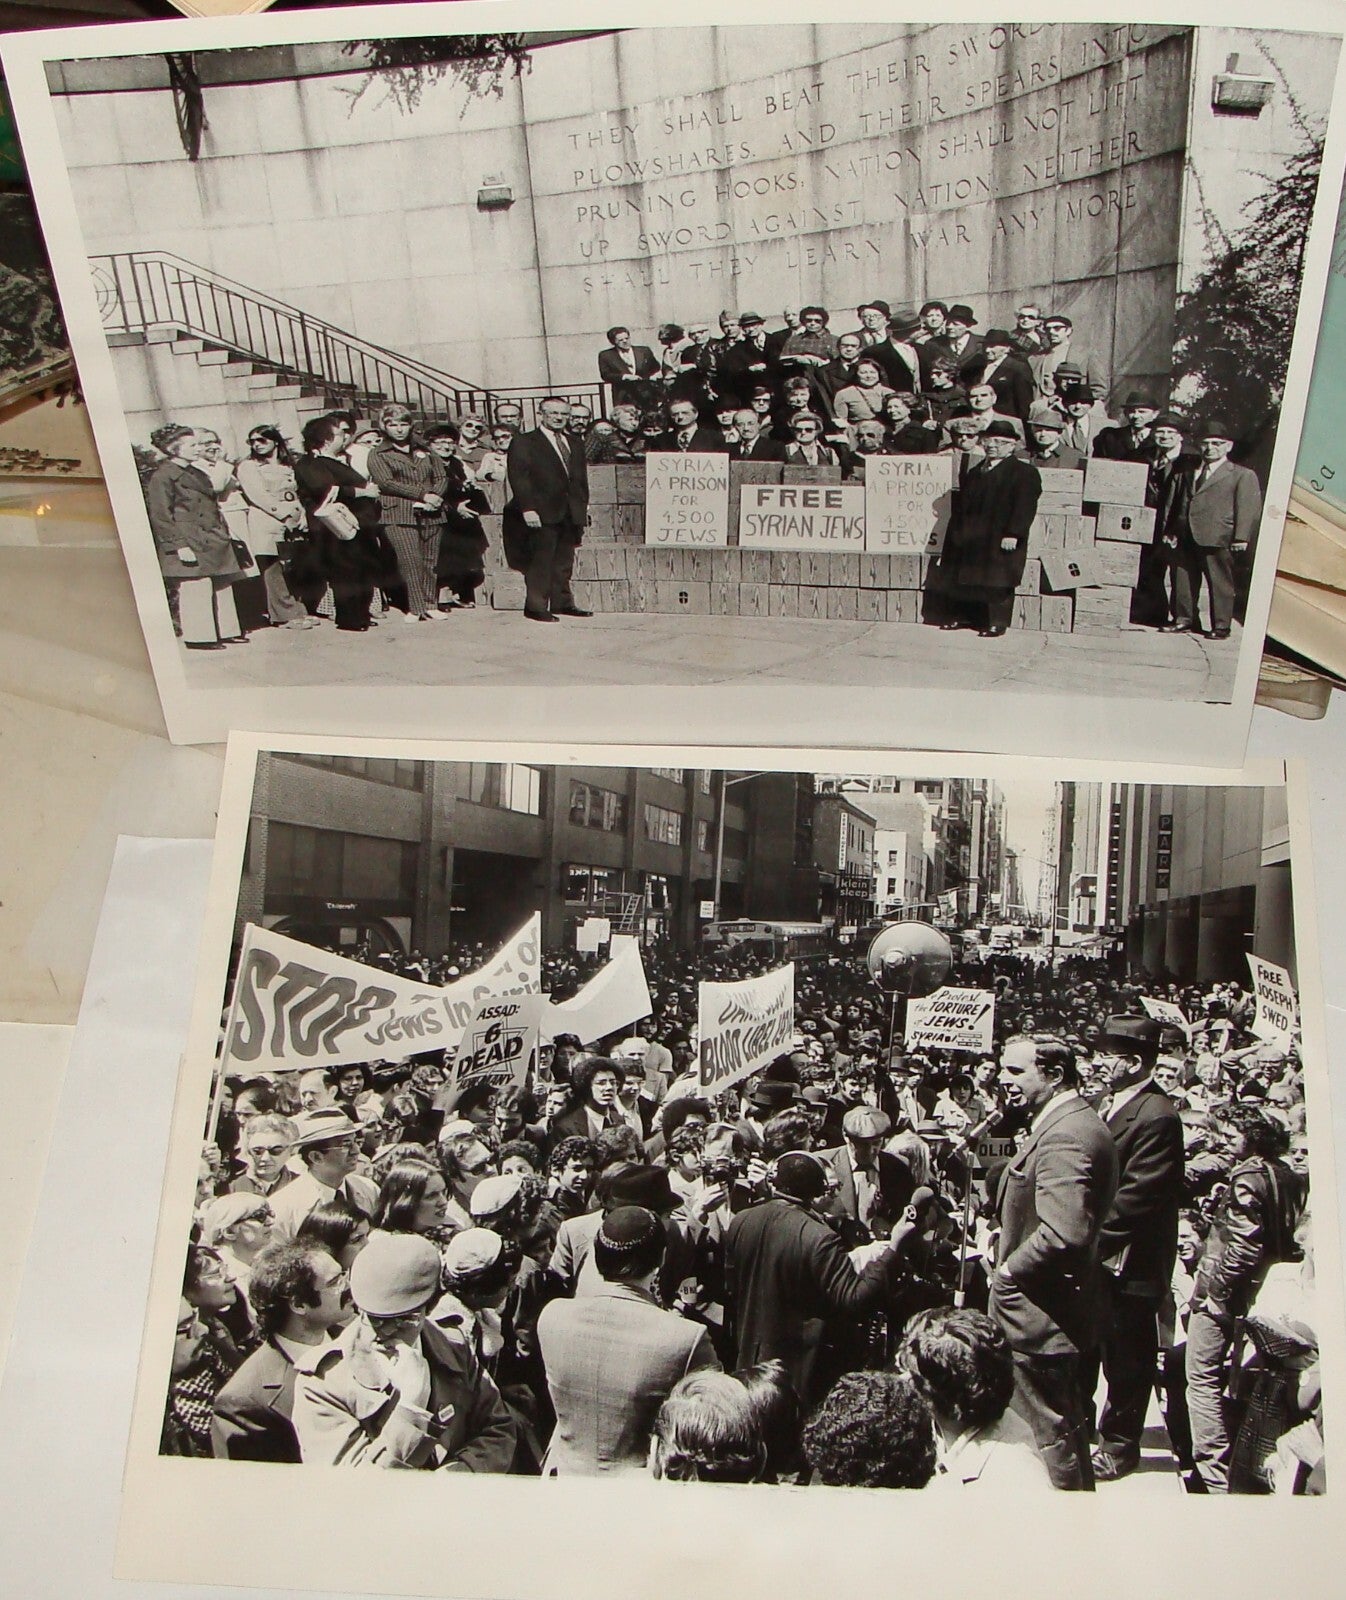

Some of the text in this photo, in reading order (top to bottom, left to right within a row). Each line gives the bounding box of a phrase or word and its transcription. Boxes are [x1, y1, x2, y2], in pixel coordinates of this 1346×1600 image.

[568, 22, 1058, 151] THEY SHALL BEAT THEIR SWORD
[778, 123, 836, 152] AND
[859, 96, 946, 134] THEIR
[965, 55, 1059, 107] SPEARS
[1080, 23, 1148, 66] INTO
[577, 190, 696, 223] PRUNING
[825, 147, 922, 180] NATION
[938, 122, 1014, 160] SHALL
[1024, 100, 1075, 133] NOT
[1088, 74, 1143, 117] LIFT
[580, 239, 610, 258] UP
[638, 222, 732, 251] SWORD
[750, 200, 862, 235] AGAINST
[1023, 131, 1143, 185] NEITHER
[689, 255, 759, 280] THEY
[786, 239, 881, 270] LEARN
[910, 224, 972, 251] WAR
[995, 207, 1045, 238] ANY
[1066, 184, 1137, 223] MORE
[649, 476, 728, 492] A PRISON
[886, 479, 947, 497] PRISON
[672, 494, 699, 507] FOR
[756, 488, 843, 509] FREE
[897, 500, 924, 513] FOR
[656, 528, 718, 543] JEWS
[745, 513, 865, 541] SYRIAN JEWS
[880, 530, 938, 546] JEWS
[1158, 816, 1171, 887] PARK
[840, 878, 868, 888] klein
[840, 888, 868, 898] sleep
[1257, 964, 1284, 987] FREE
[230, 947, 398, 1062] STOP
[928, 1001, 981, 1016] TORTURE
[1257, 982, 1293, 1013] JOSEPH
[363, 1006, 443, 1046] Jews
[442, 996, 472, 1030] In
[475, 1004, 521, 1021] ASSAD:
[1262, 1004, 1289, 1032] SWED
[484, 1022, 502, 1045] 6
[911, 1031, 944, 1043] SYRIA
[456, 1036, 524, 1080] DEAD
[700, 1028, 742, 1087] BLOOD
[979, 1143, 1011, 1157] OLIC
